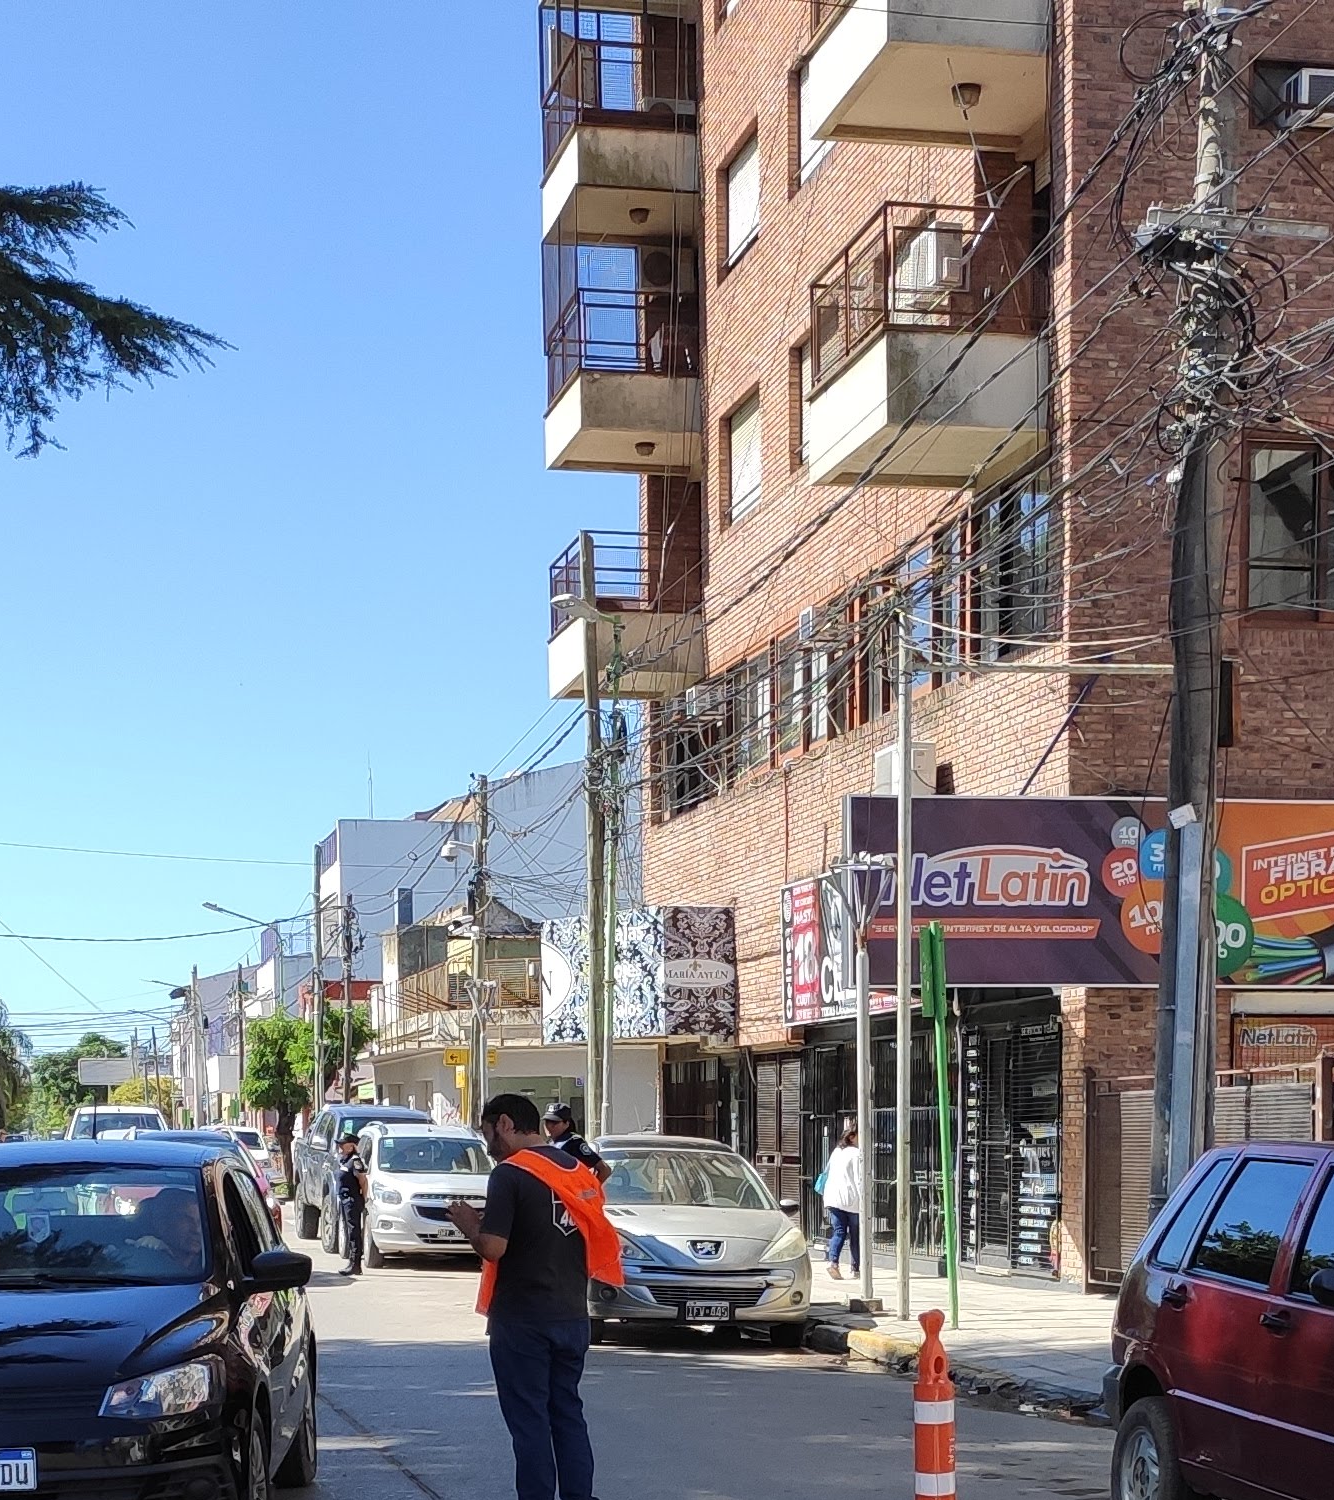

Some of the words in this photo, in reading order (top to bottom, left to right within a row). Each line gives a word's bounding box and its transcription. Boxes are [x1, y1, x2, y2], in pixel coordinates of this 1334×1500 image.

[1119, 826, 1139, 839] 10
[1110, 858, 1138, 880] 20
[1253, 848, 1327, 871] INTERNET
[1118, 876, 1136, 887] mb
[1128, 900, 1163, 928] 10
[993, 925, 1007, 933] DE
[1008, 925, 1033, 933] ALTA
[1, 1463, 29, 1486] DU
